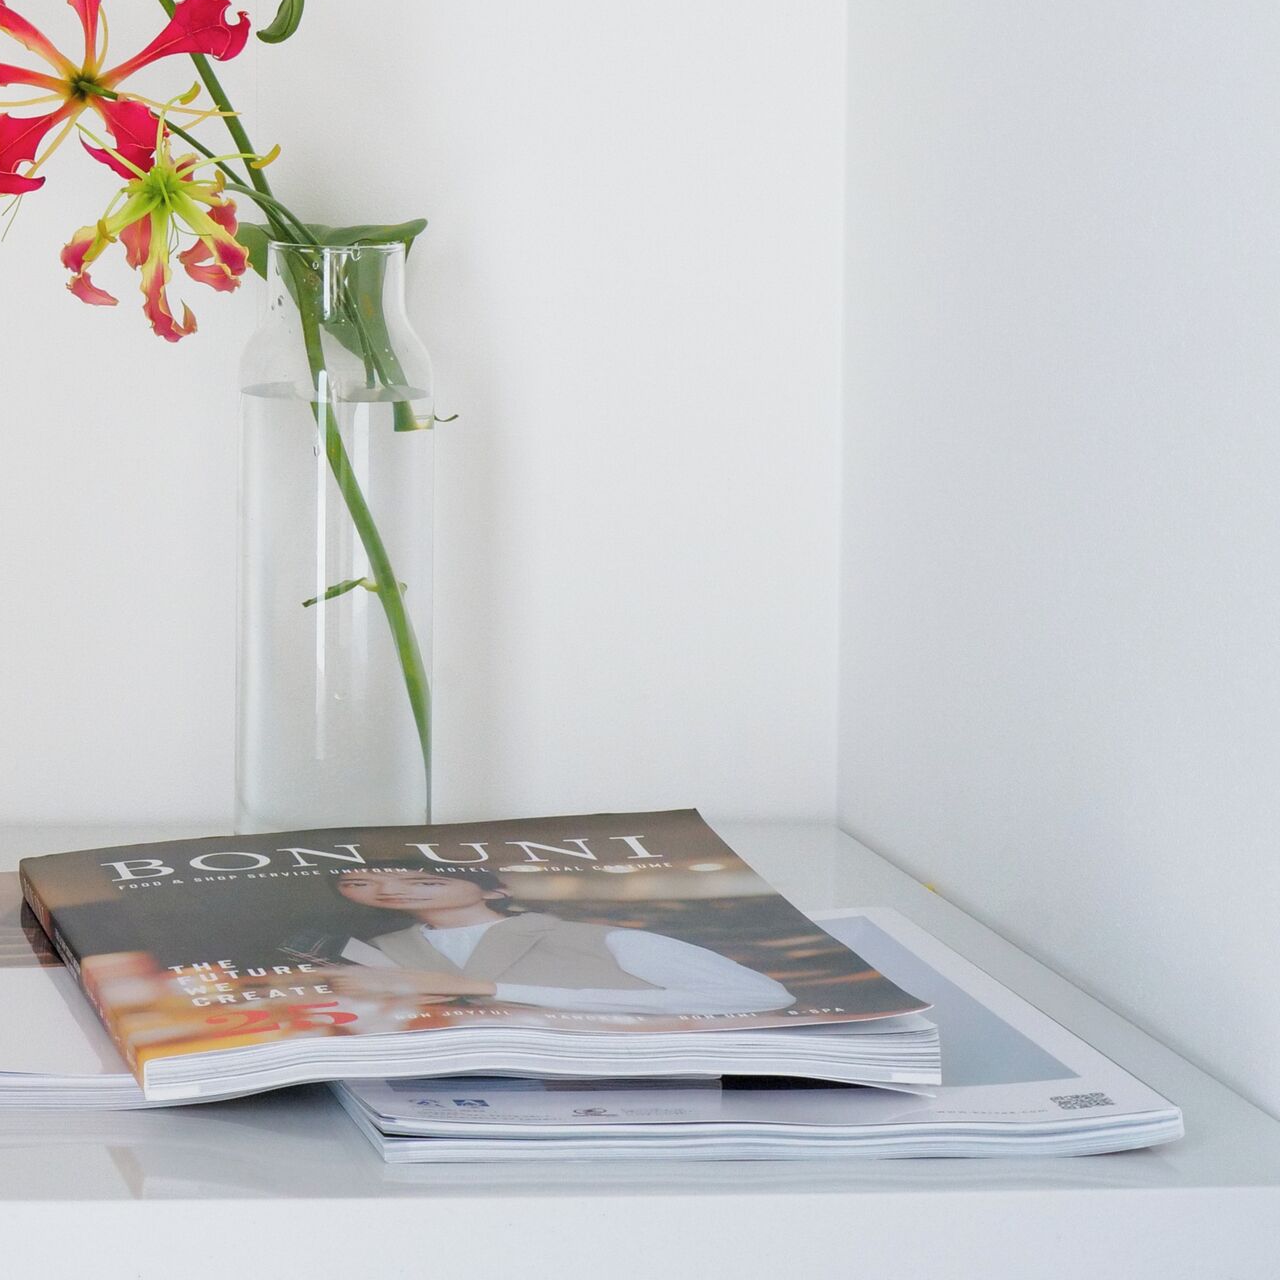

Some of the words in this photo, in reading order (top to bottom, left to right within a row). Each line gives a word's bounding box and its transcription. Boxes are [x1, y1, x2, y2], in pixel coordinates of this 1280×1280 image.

[100, 843, 367, 882] BON
[405, 835, 663, 863] UNI
[118, 881, 162, 890] FOOD
[193, 874, 238, 883] SHOP
[247, 869, 321, 879] SERVICE
[330, 867, 408, 875] UNIFORM
[592, 862, 673, 871] COTUME
[167, 959, 238, 975] THE
[176, 964, 317, 986] FUTURE
[183, 982, 234, 996] WE
[191, 984, 334, 1008] CREATE
[205, 1001, 359, 1039] 25
[441, 1009, 513, 1017] JOYFUL
